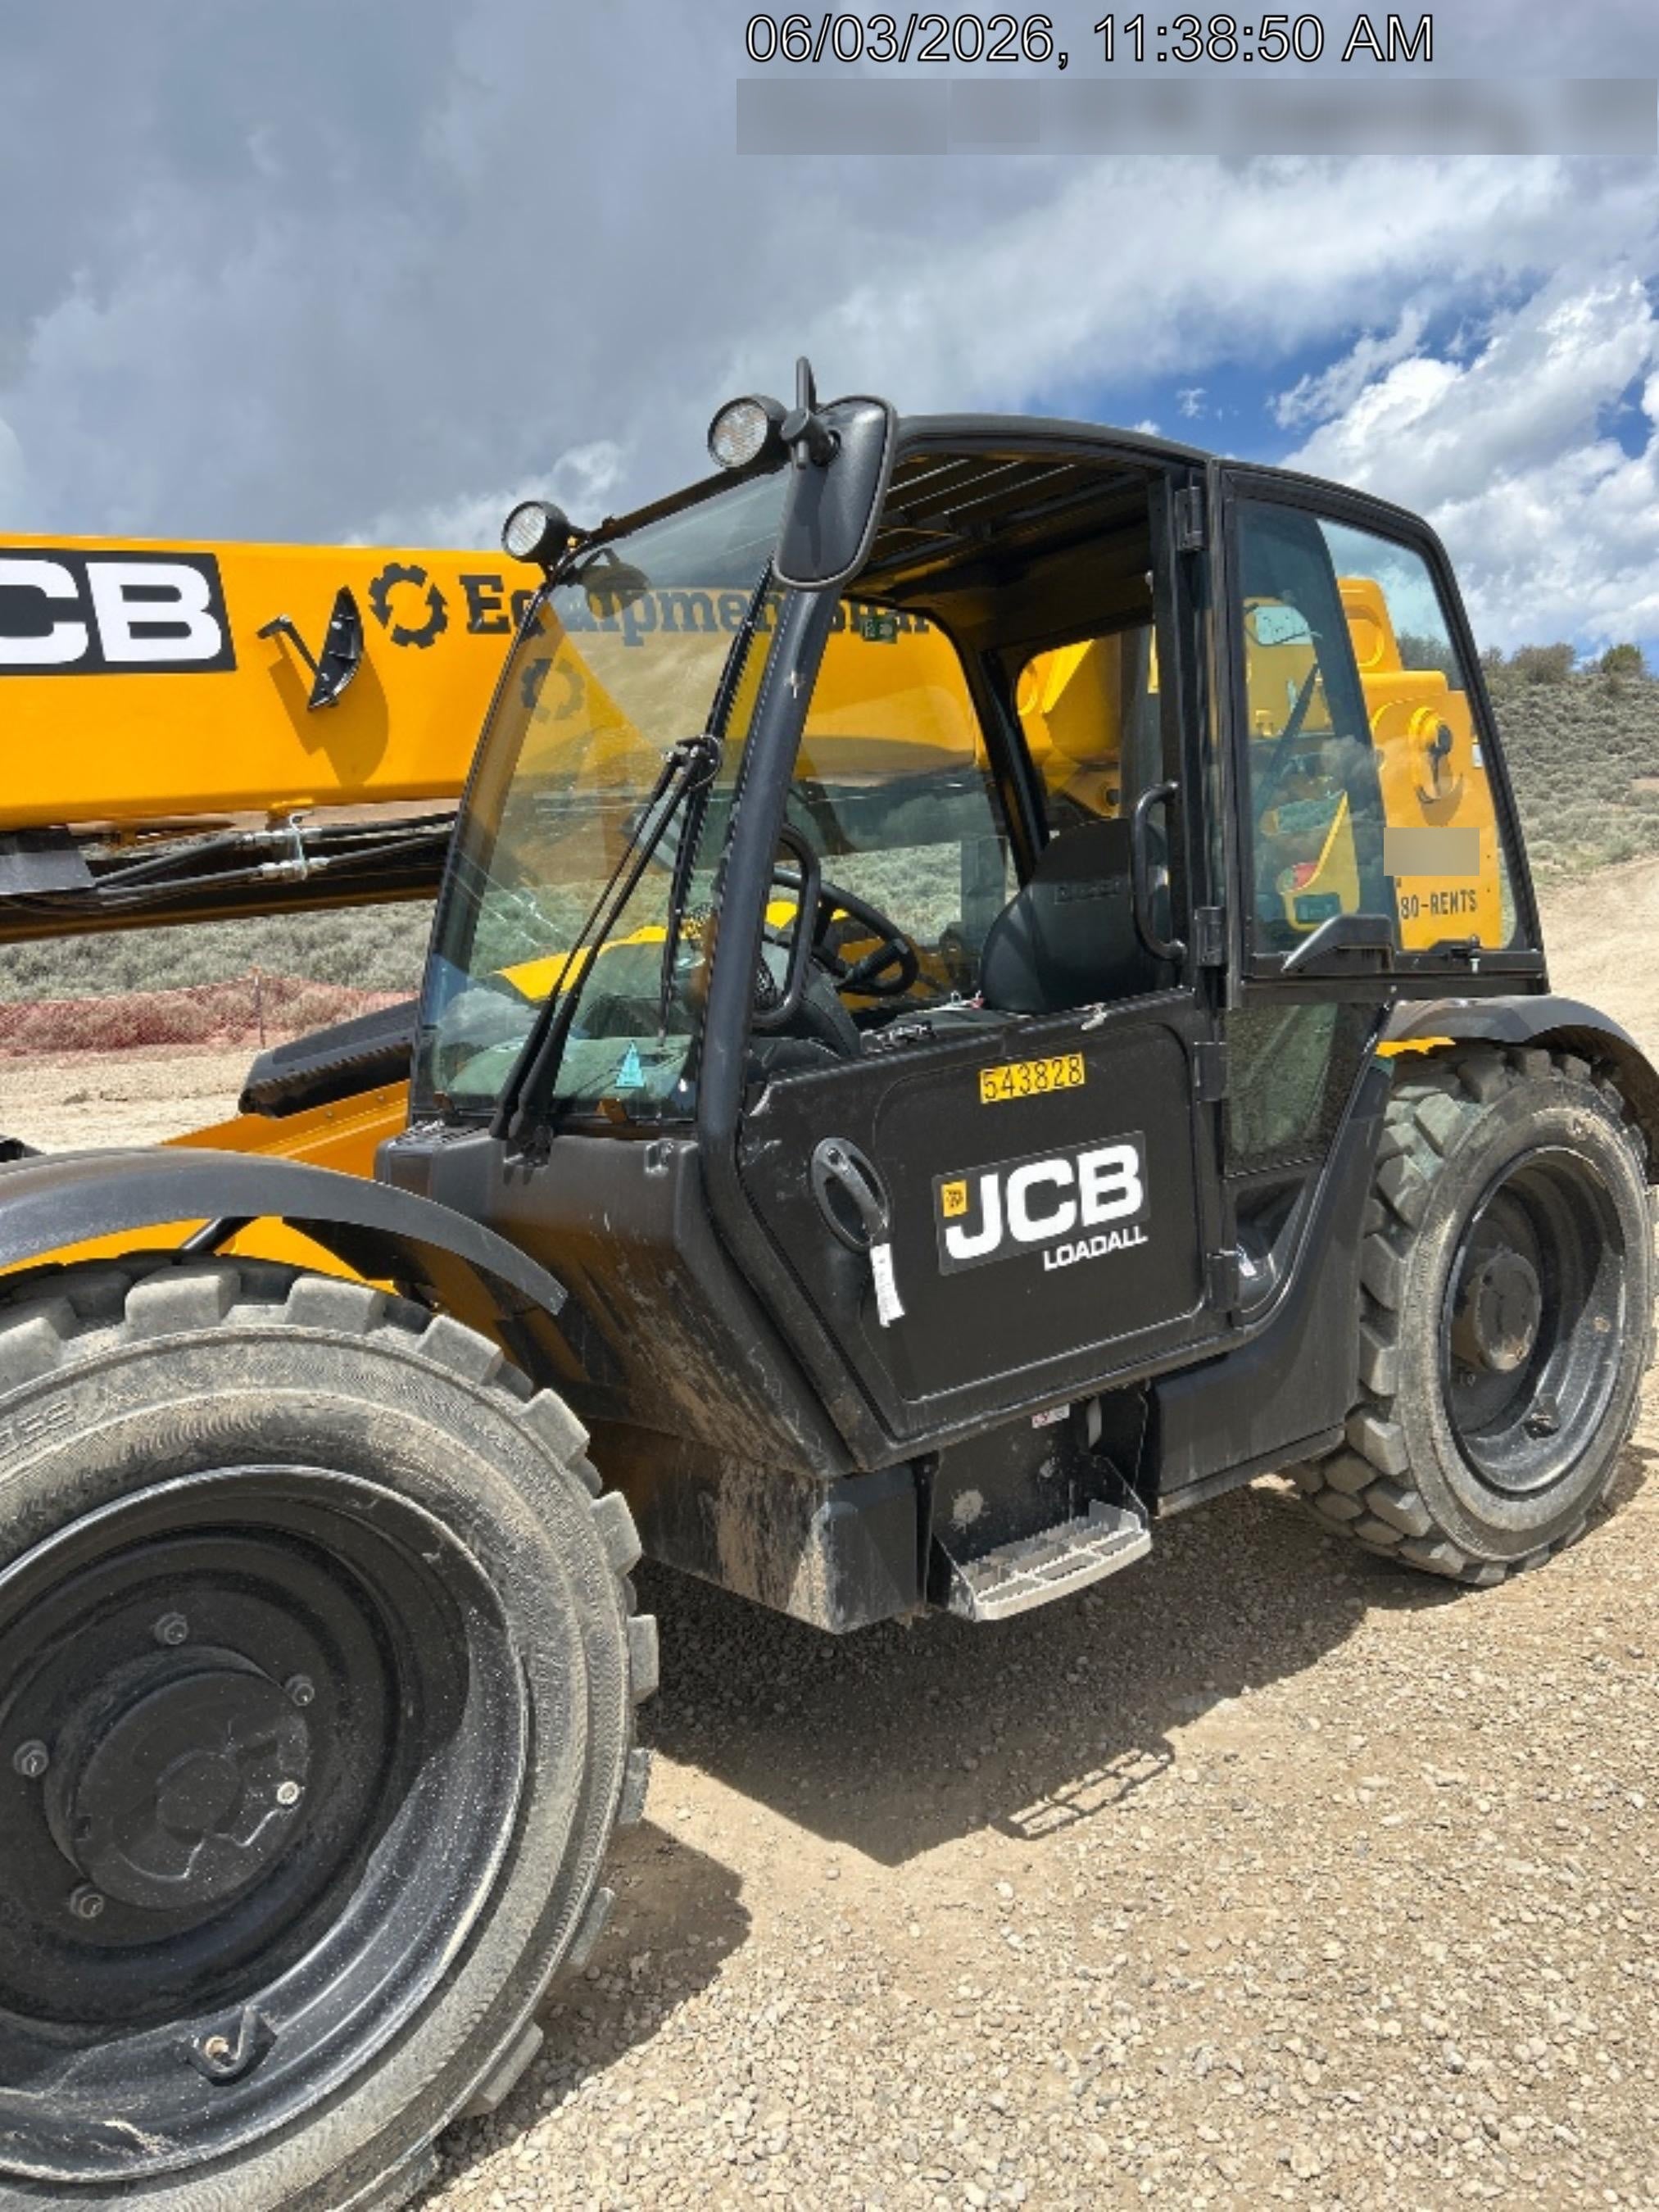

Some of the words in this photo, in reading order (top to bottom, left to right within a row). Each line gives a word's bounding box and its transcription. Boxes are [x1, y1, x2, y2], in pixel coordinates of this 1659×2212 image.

[984, 1055, 1081, 1099] 543828
[945, 1145, 1144, 1259] JCB
[1044, 1226, 1149, 1271] LOADALL
